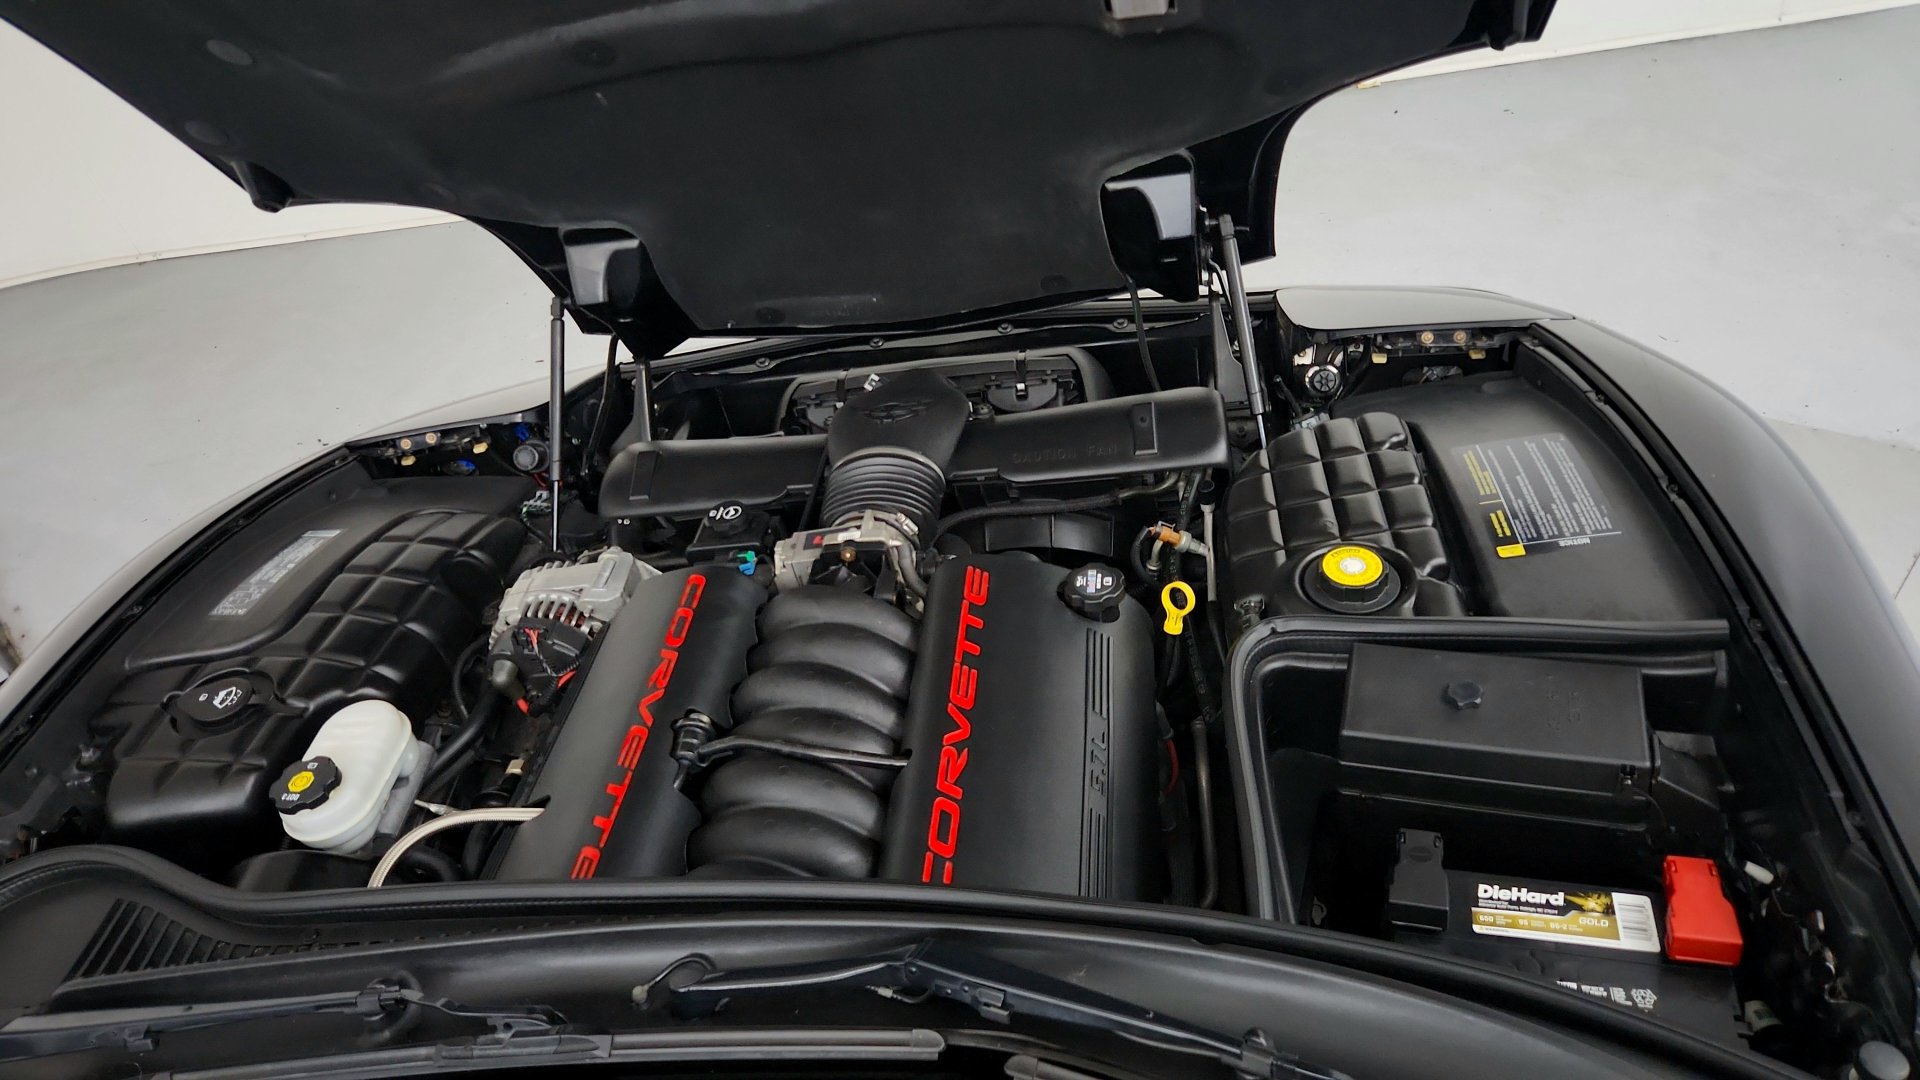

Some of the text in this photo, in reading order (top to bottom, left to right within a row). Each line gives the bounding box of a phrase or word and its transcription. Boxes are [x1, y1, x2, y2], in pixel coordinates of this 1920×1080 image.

[1089, 731, 1107, 797] 5.7L
[1477, 883, 1565, 907] DieHard
[1578, 917, 1609, 928] GOLD
